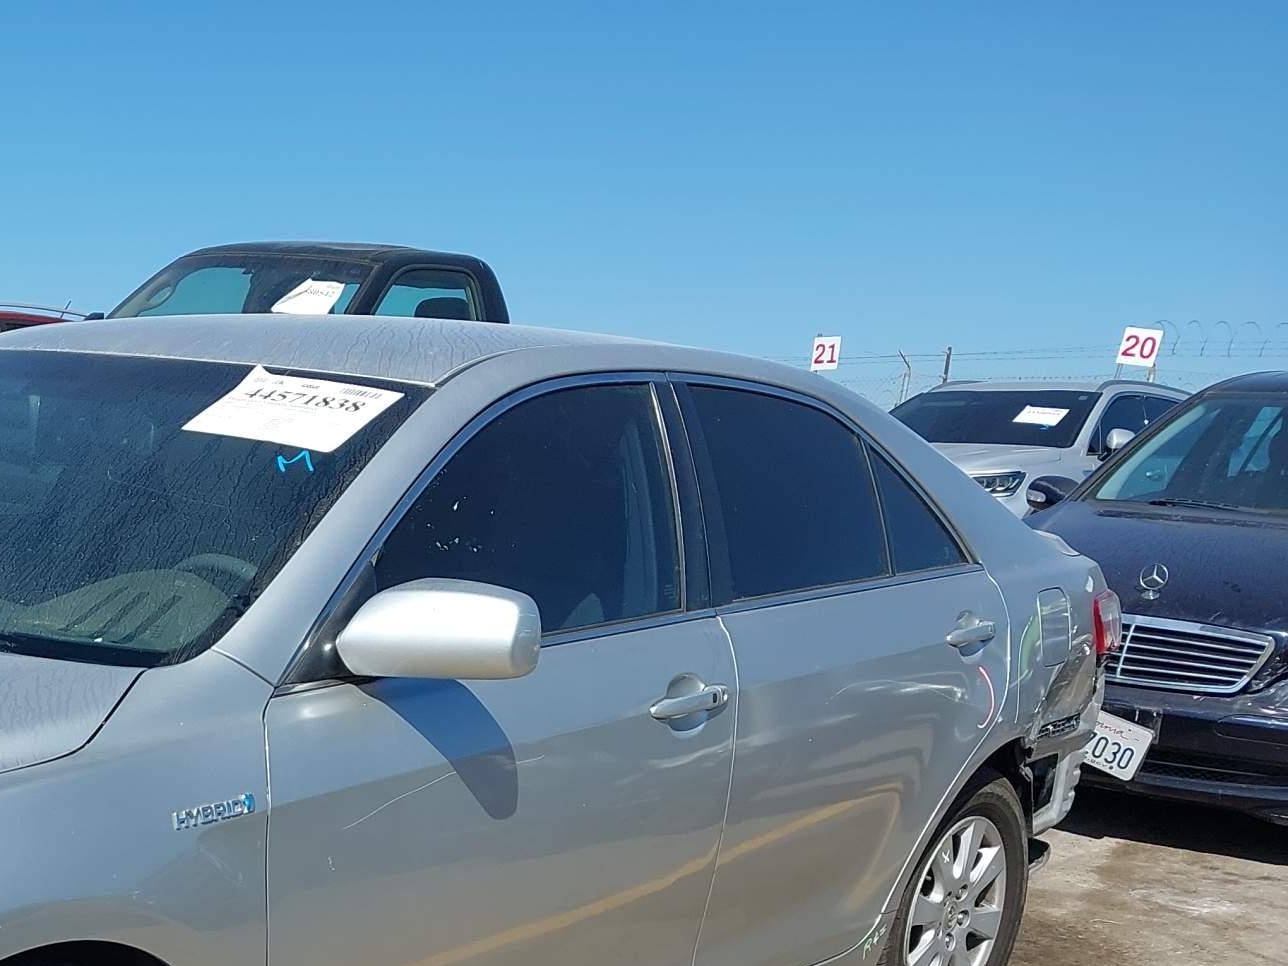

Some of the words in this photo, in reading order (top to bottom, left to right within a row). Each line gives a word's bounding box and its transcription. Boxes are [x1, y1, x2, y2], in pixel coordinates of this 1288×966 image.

[814, 343, 837, 364] 21
[1121, 335, 1157, 359] 20
[244, 387, 366, 413] 44571838
[172, 799, 242, 831] HYBRID
